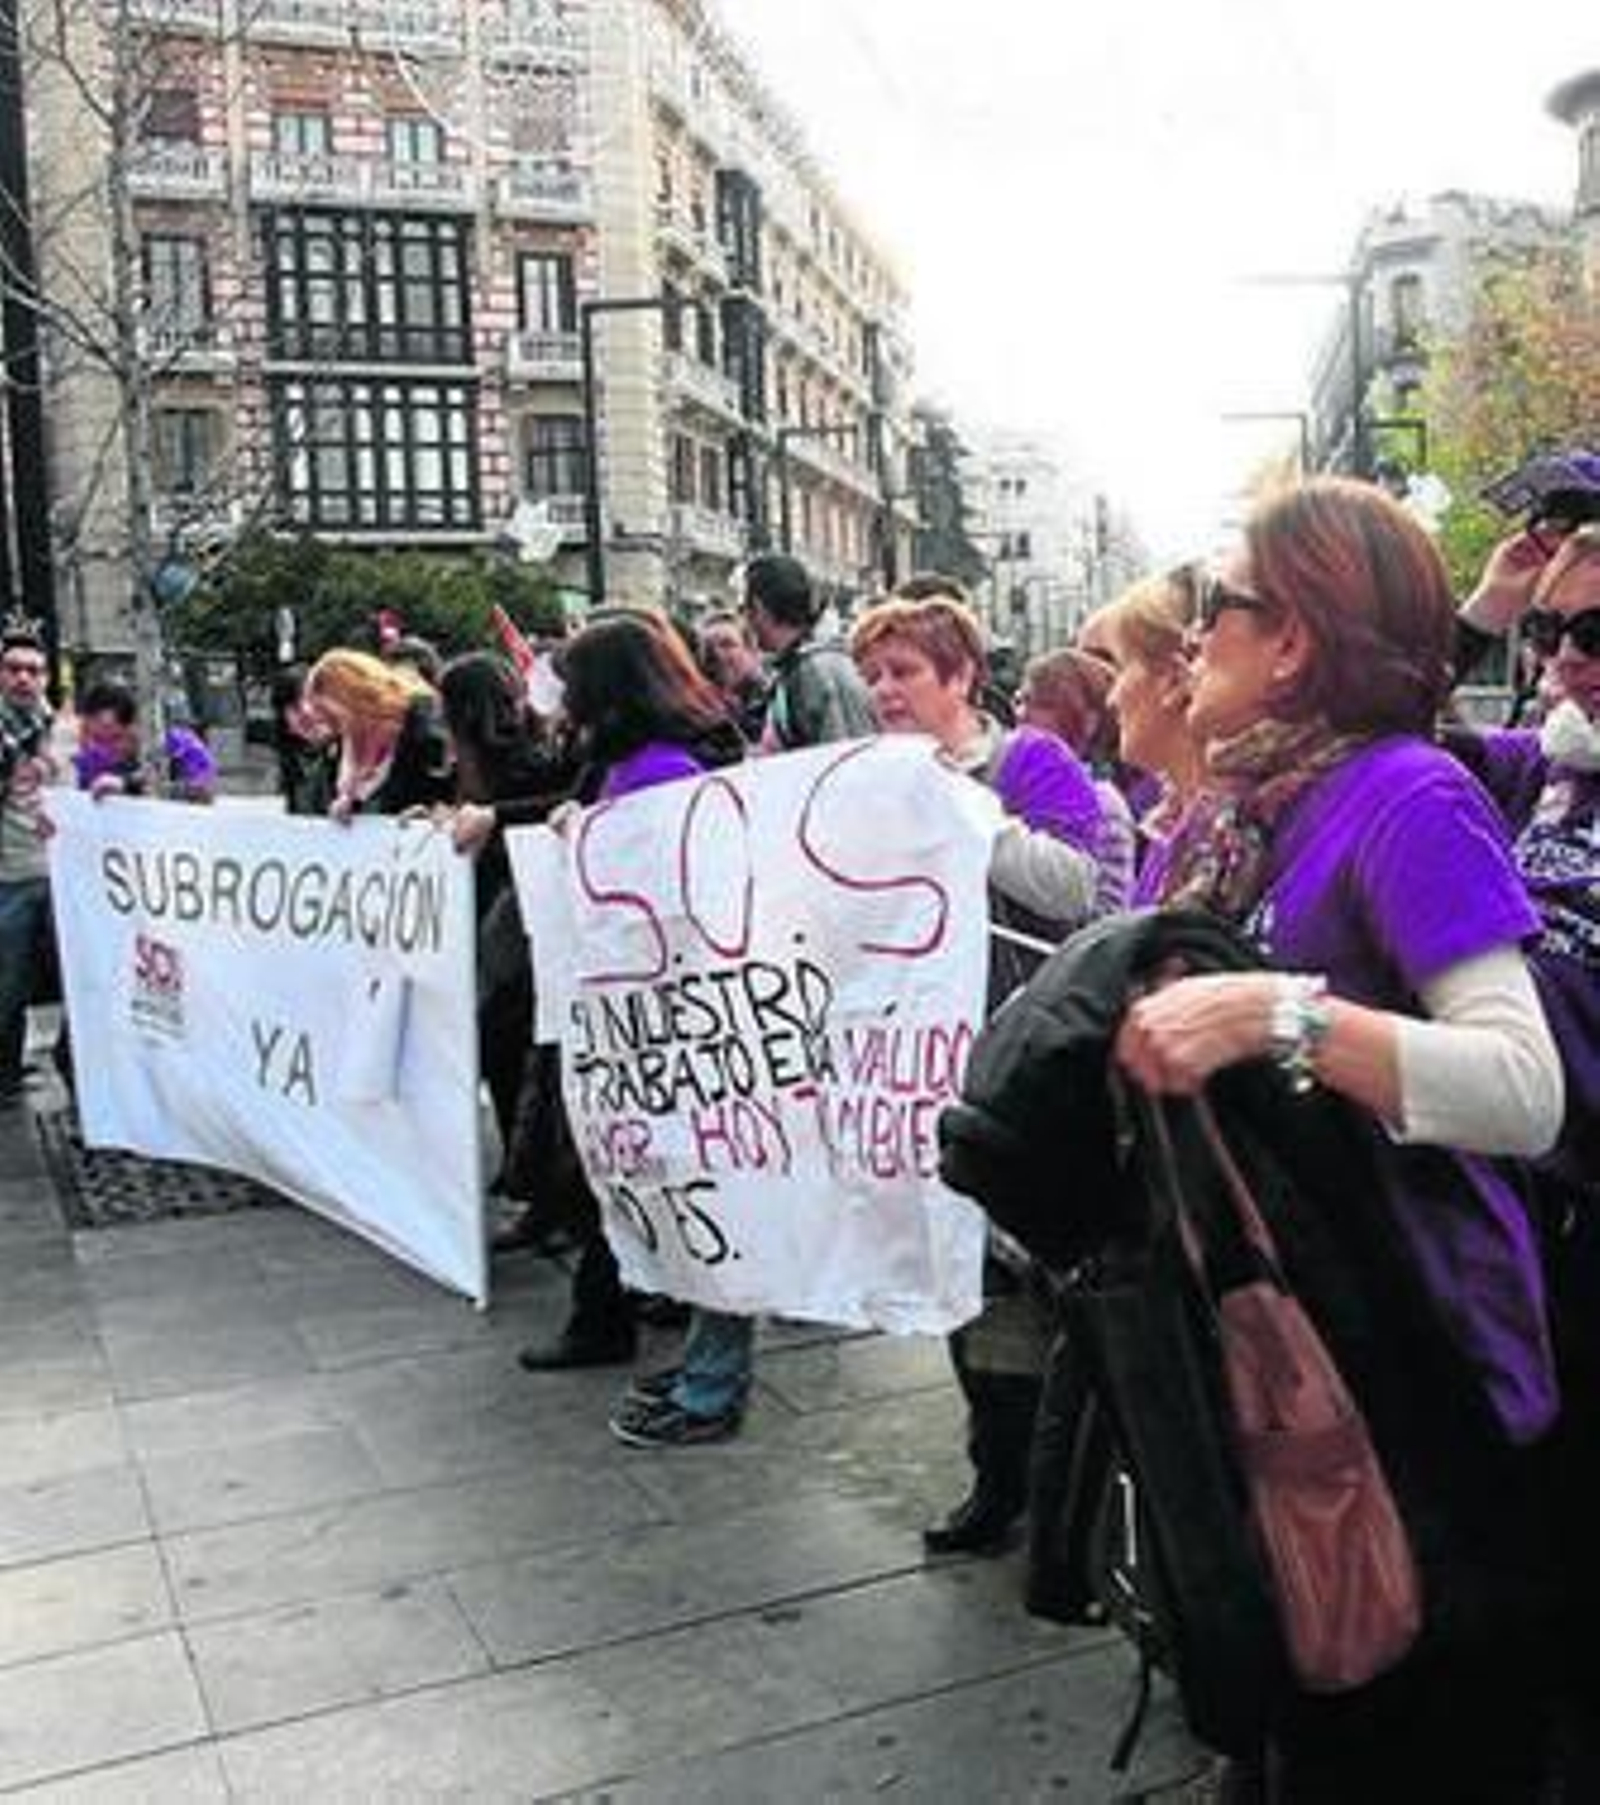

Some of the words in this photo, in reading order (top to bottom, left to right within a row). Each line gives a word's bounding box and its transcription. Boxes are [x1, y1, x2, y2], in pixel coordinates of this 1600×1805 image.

[600, 959, 834, 1052] NUESTRO
[251, 1018, 316, 1106] YA
[574, 1034, 756, 1116] TRABAJO
